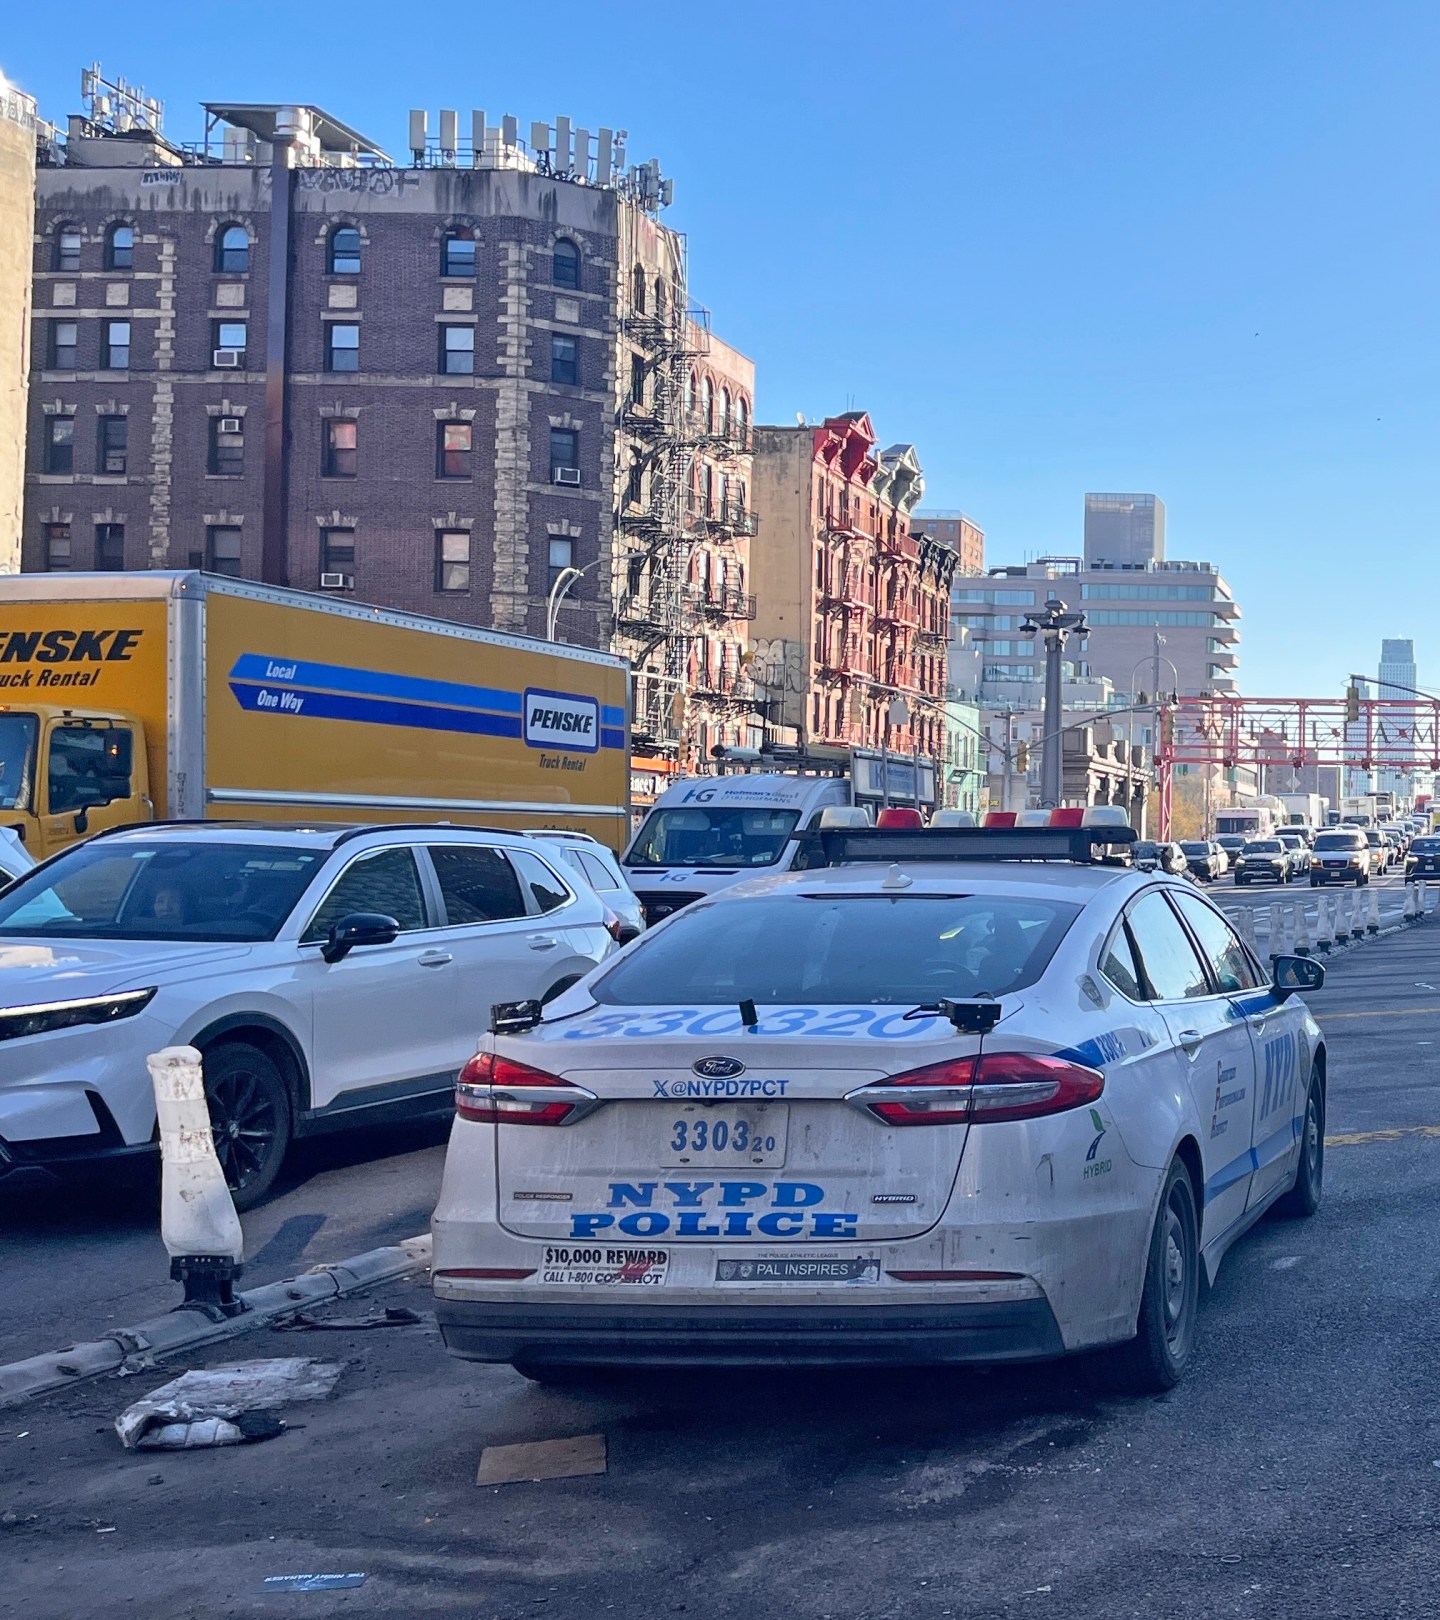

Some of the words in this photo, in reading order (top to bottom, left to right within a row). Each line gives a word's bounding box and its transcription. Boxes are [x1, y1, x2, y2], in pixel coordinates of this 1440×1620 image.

[36, 669, 101, 686] Rental
[266, 661, 297, 679] Local
[257, 690, 279, 707] One
[280, 692, 304, 713] Way
[530, 708, 594, 734] PENSKE
[539, 754, 561, 769] Truck
[561, 756, 587, 772] Rental
[701, 1060, 734, 1075] Ford
[1083, 1160, 1112, 1180] HYBRID
[606, 1182, 825, 1207] NYPD
[569, 1212, 858, 1237] POLICE
[545, 1248, 600, 1266] $10,000
[606, 1250, 667, 1264] REWARD
[543, 1271, 565, 1283] CALL
[756, 1264, 781, 1275] PAL
[784, 1263, 849, 1276] INSPIRES
